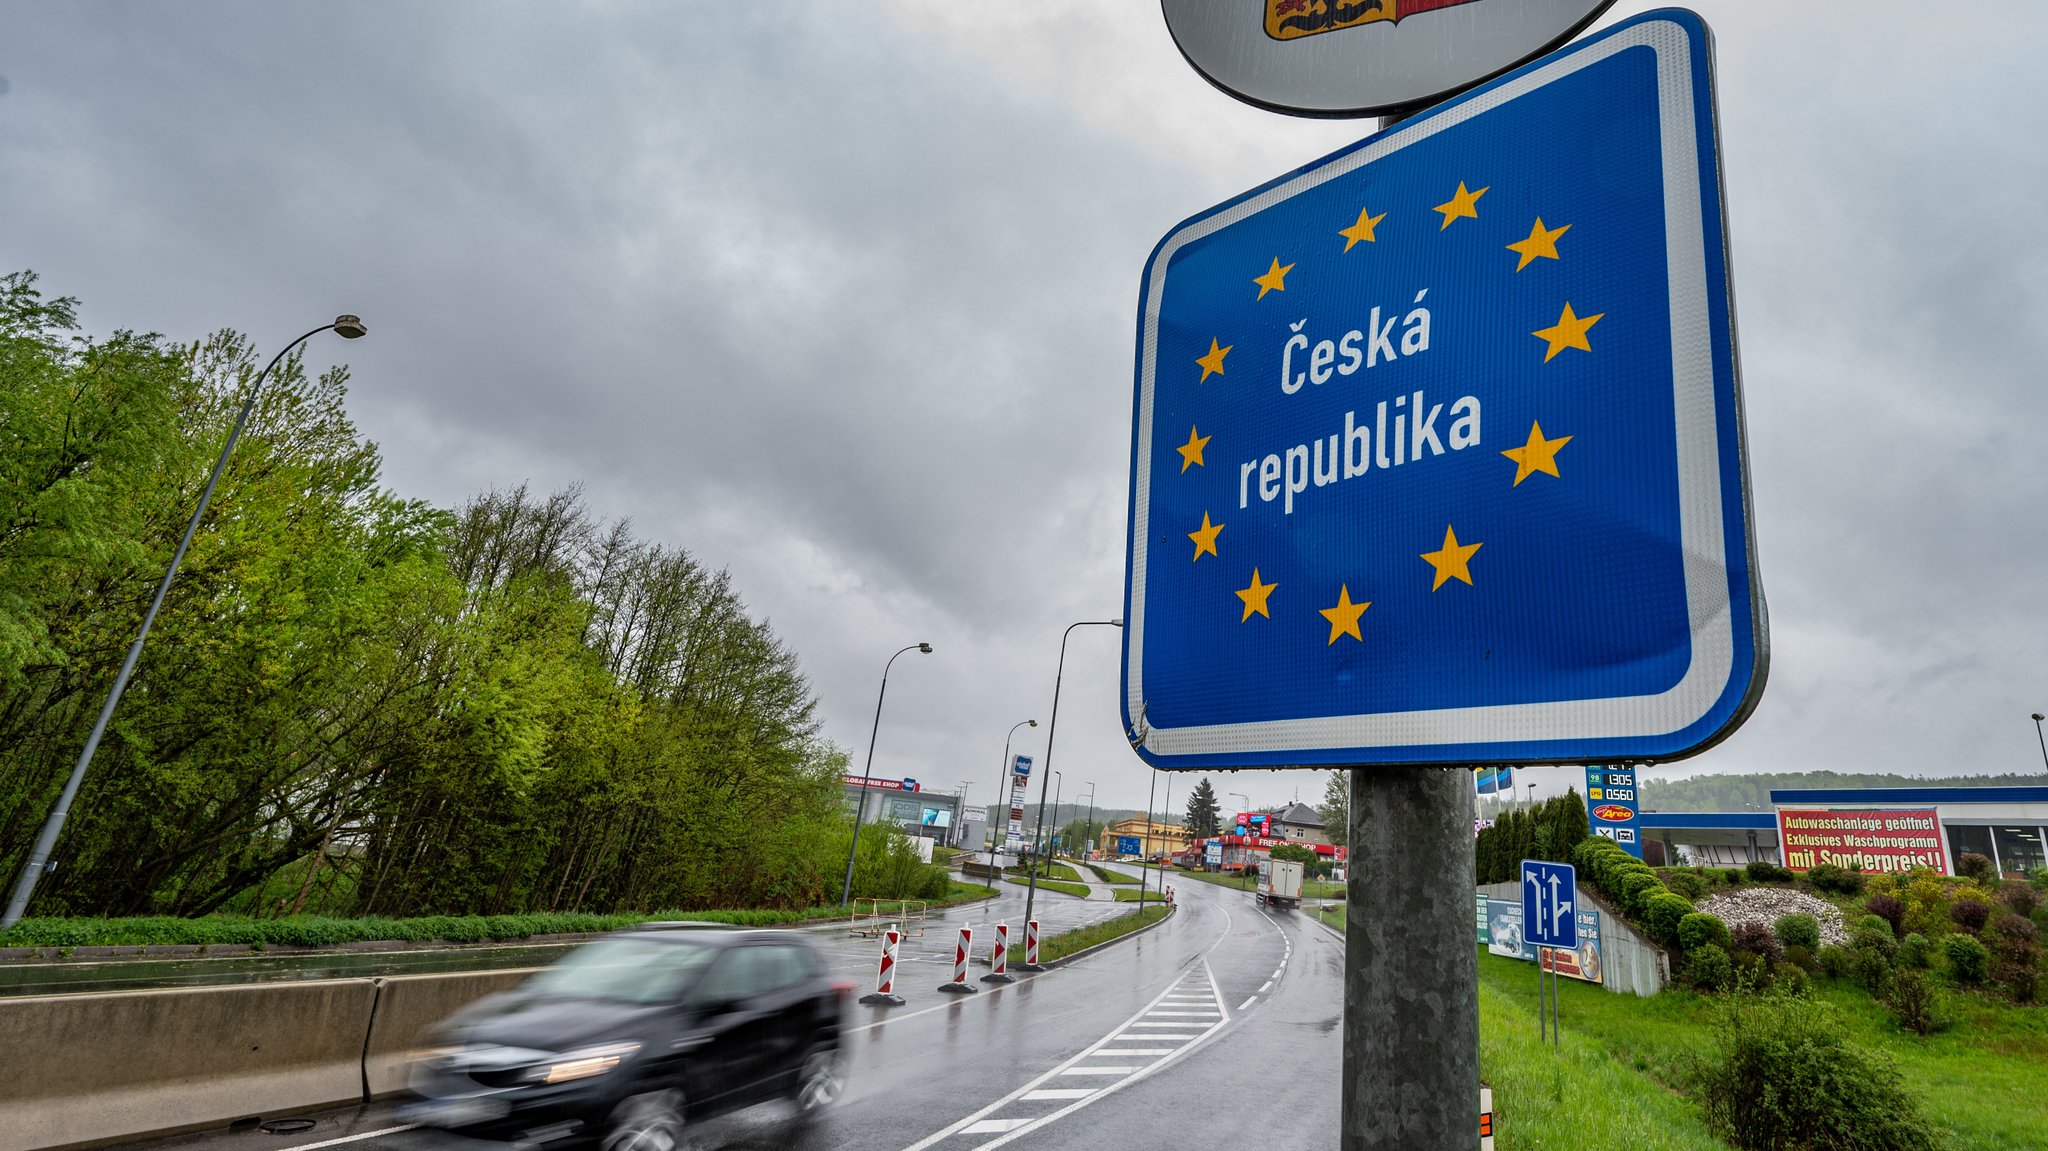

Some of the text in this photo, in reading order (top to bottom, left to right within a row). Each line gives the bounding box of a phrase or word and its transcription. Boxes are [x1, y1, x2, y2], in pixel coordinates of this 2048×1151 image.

[1281, 288, 1431, 395] Česká
[1240, 390, 1481, 515] republika
[867, 779, 882, 787] FREE
[1602, 809, 1632, 819] Area
[1785, 816, 1935, 832] Autowaschanlage geöffnet
[1258, 839, 1278, 847] FREE
[1786, 833, 1938, 849] Exklusives Waschprogramm
[1788, 849, 1816, 868] mit
